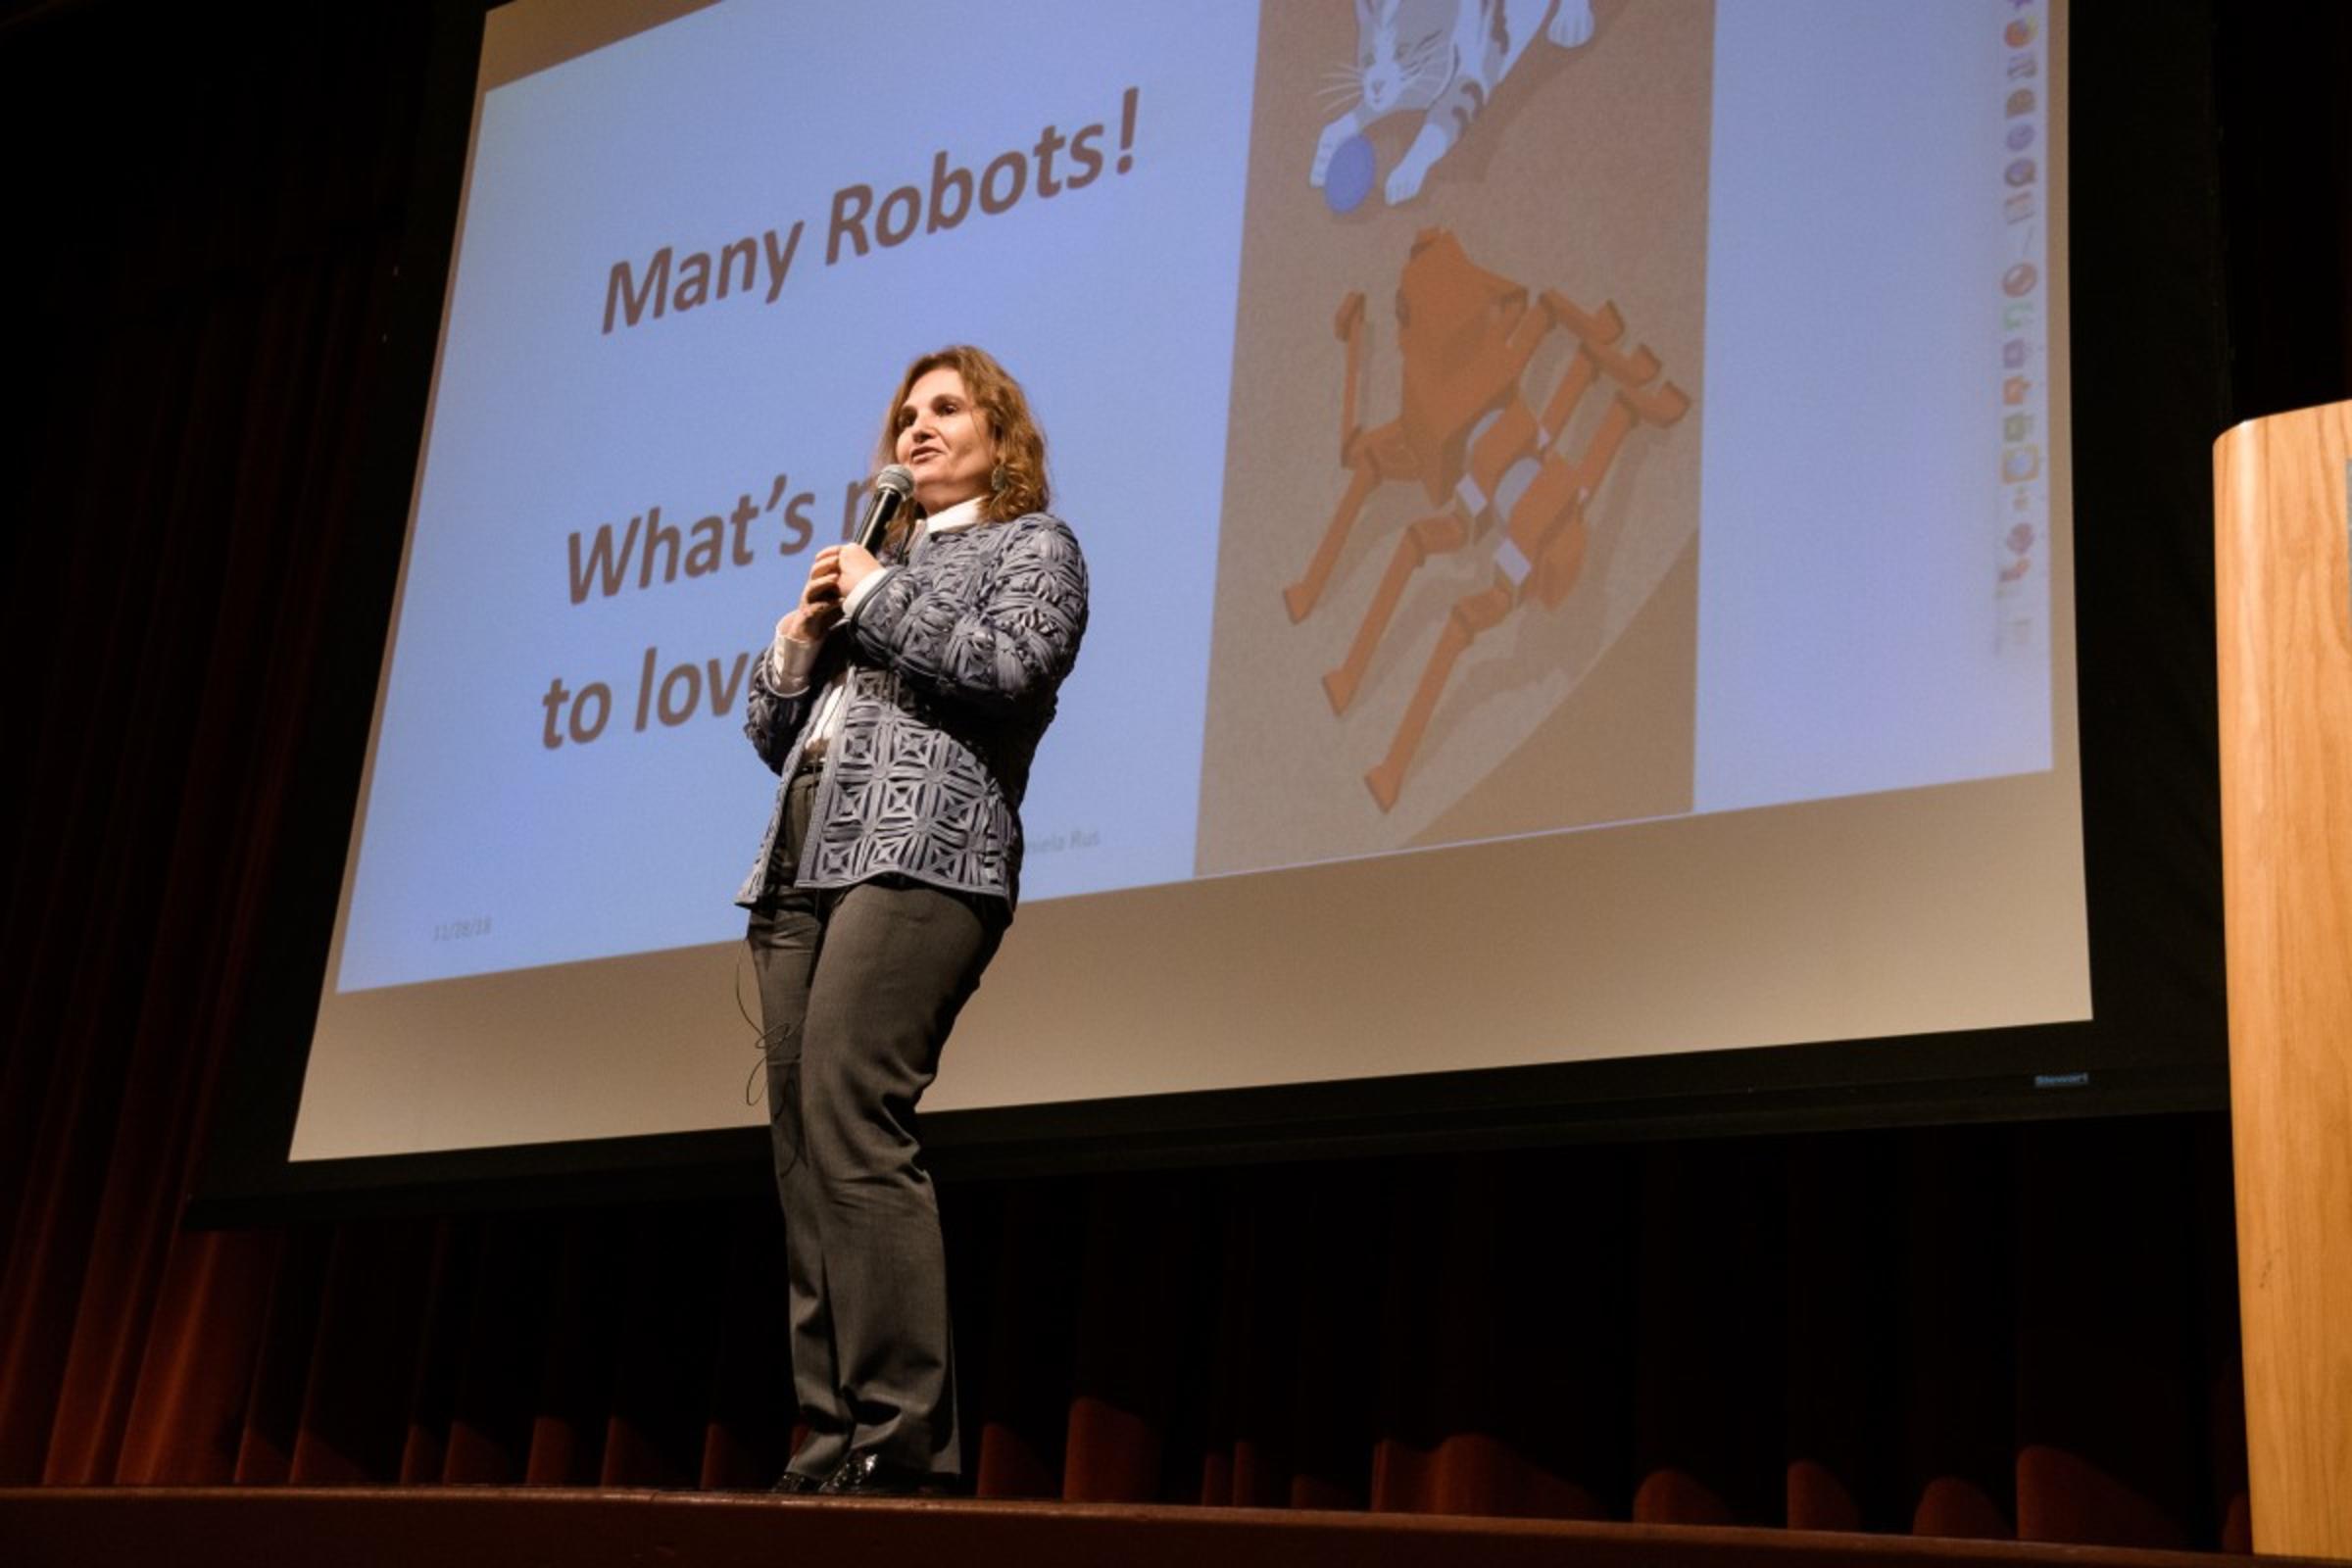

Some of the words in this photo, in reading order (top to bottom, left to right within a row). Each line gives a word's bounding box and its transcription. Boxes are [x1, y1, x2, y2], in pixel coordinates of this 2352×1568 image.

[601, 220, 805, 335] Many
[825, 86, 1140, 266] Robots!
[567, 474, 815, 606] What’s
[542, 678, 612, 750] to
[634, 647, 755, 732] lov
